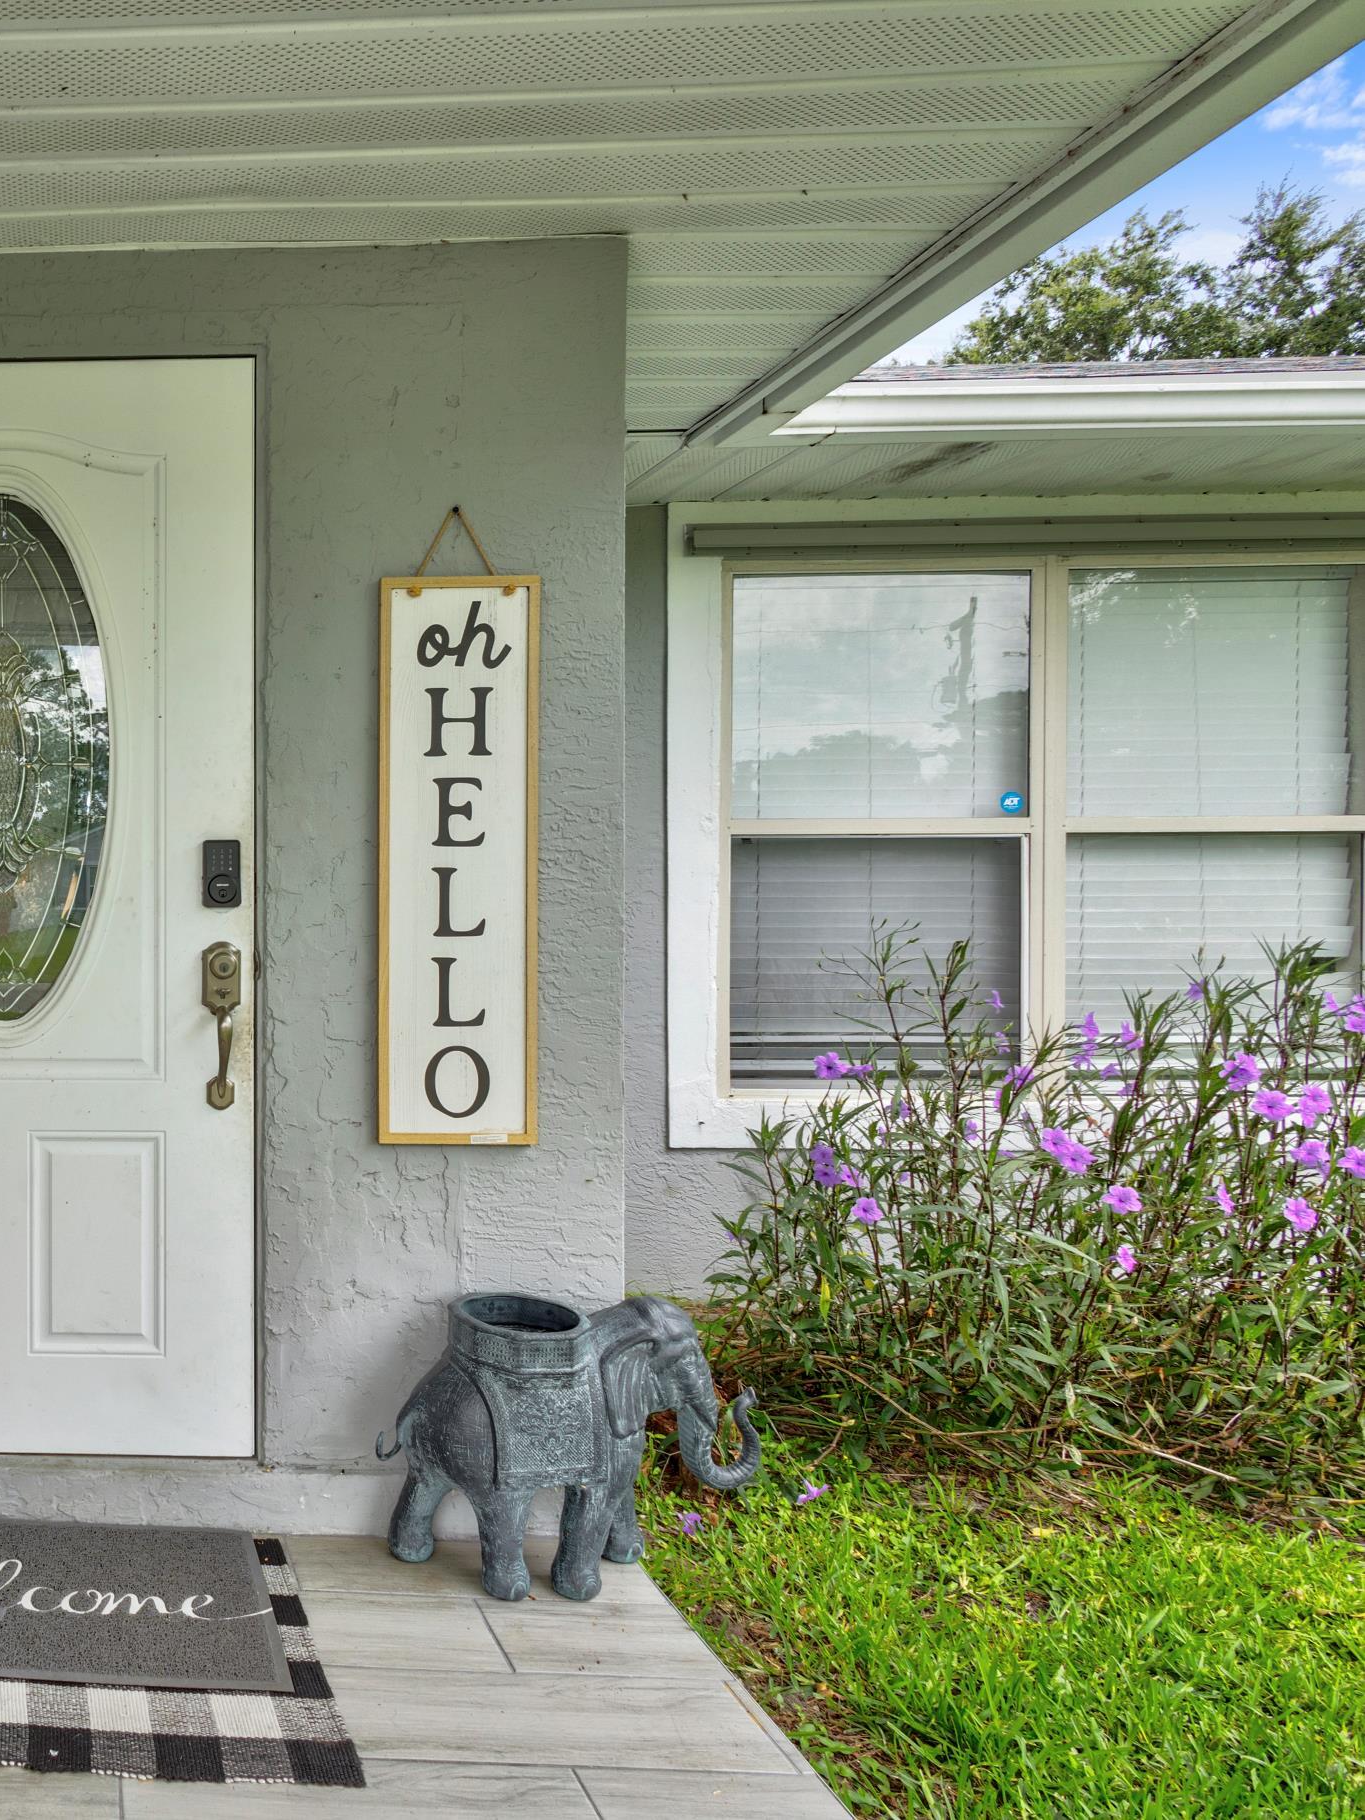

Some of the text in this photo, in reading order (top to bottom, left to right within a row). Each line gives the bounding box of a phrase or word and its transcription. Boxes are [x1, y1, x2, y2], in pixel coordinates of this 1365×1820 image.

[417, 601, 512, 669] oh
[1003, 797, 1021, 806] ADT
[423, 687, 493, 1118] HELLO
